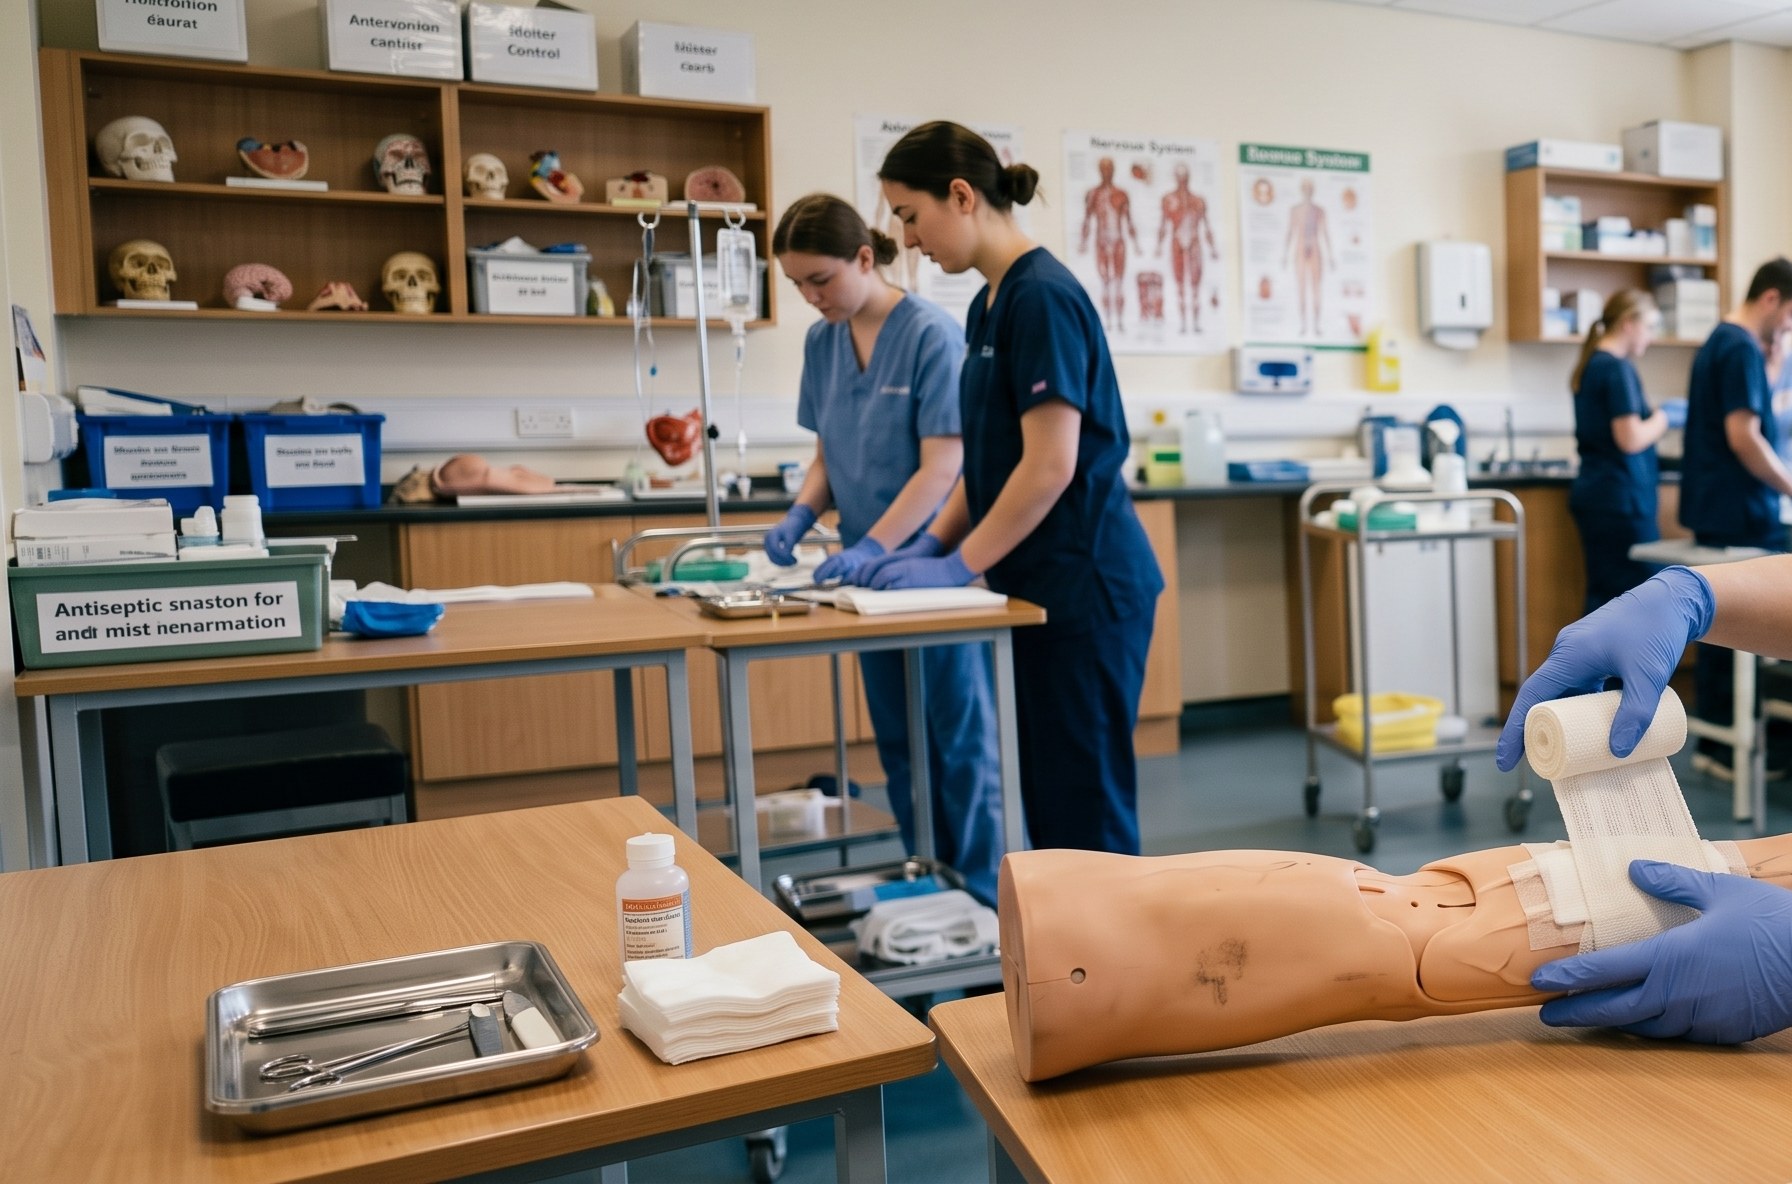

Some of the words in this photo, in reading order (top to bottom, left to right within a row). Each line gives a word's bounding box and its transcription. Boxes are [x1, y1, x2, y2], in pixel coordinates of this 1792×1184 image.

[507, 44, 560, 60] Control
[55, 598, 163, 618] Antiseptic
[169, 594, 248, 612] snaston
[254, 591, 284, 606] for
[106, 621, 151, 638] mist
